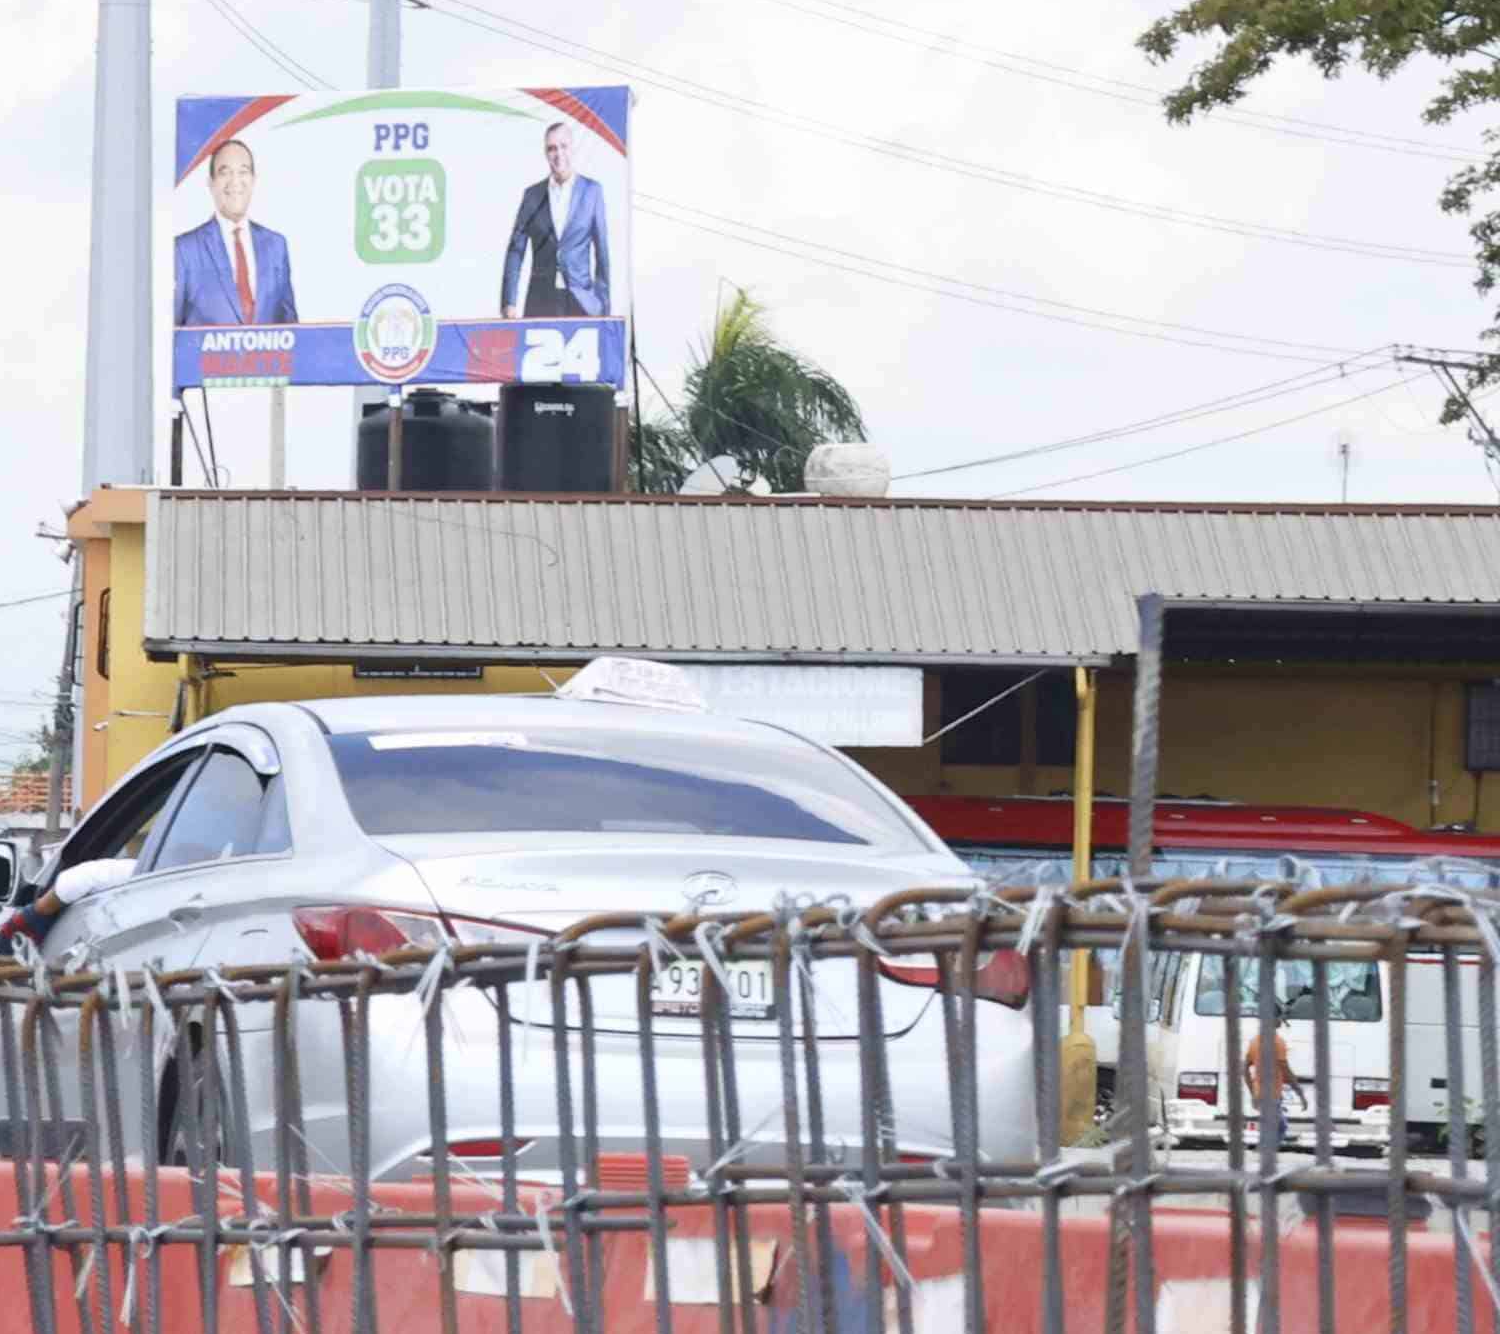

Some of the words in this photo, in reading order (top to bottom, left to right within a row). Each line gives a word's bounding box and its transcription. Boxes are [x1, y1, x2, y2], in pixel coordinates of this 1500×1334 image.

[373, 123, 430, 151] PPG
[363, 172, 439, 204] VOTA
[369, 204, 432, 252] 33
[202, 331, 295, 351] ANTONIO
[521, 327, 600, 383] 24
